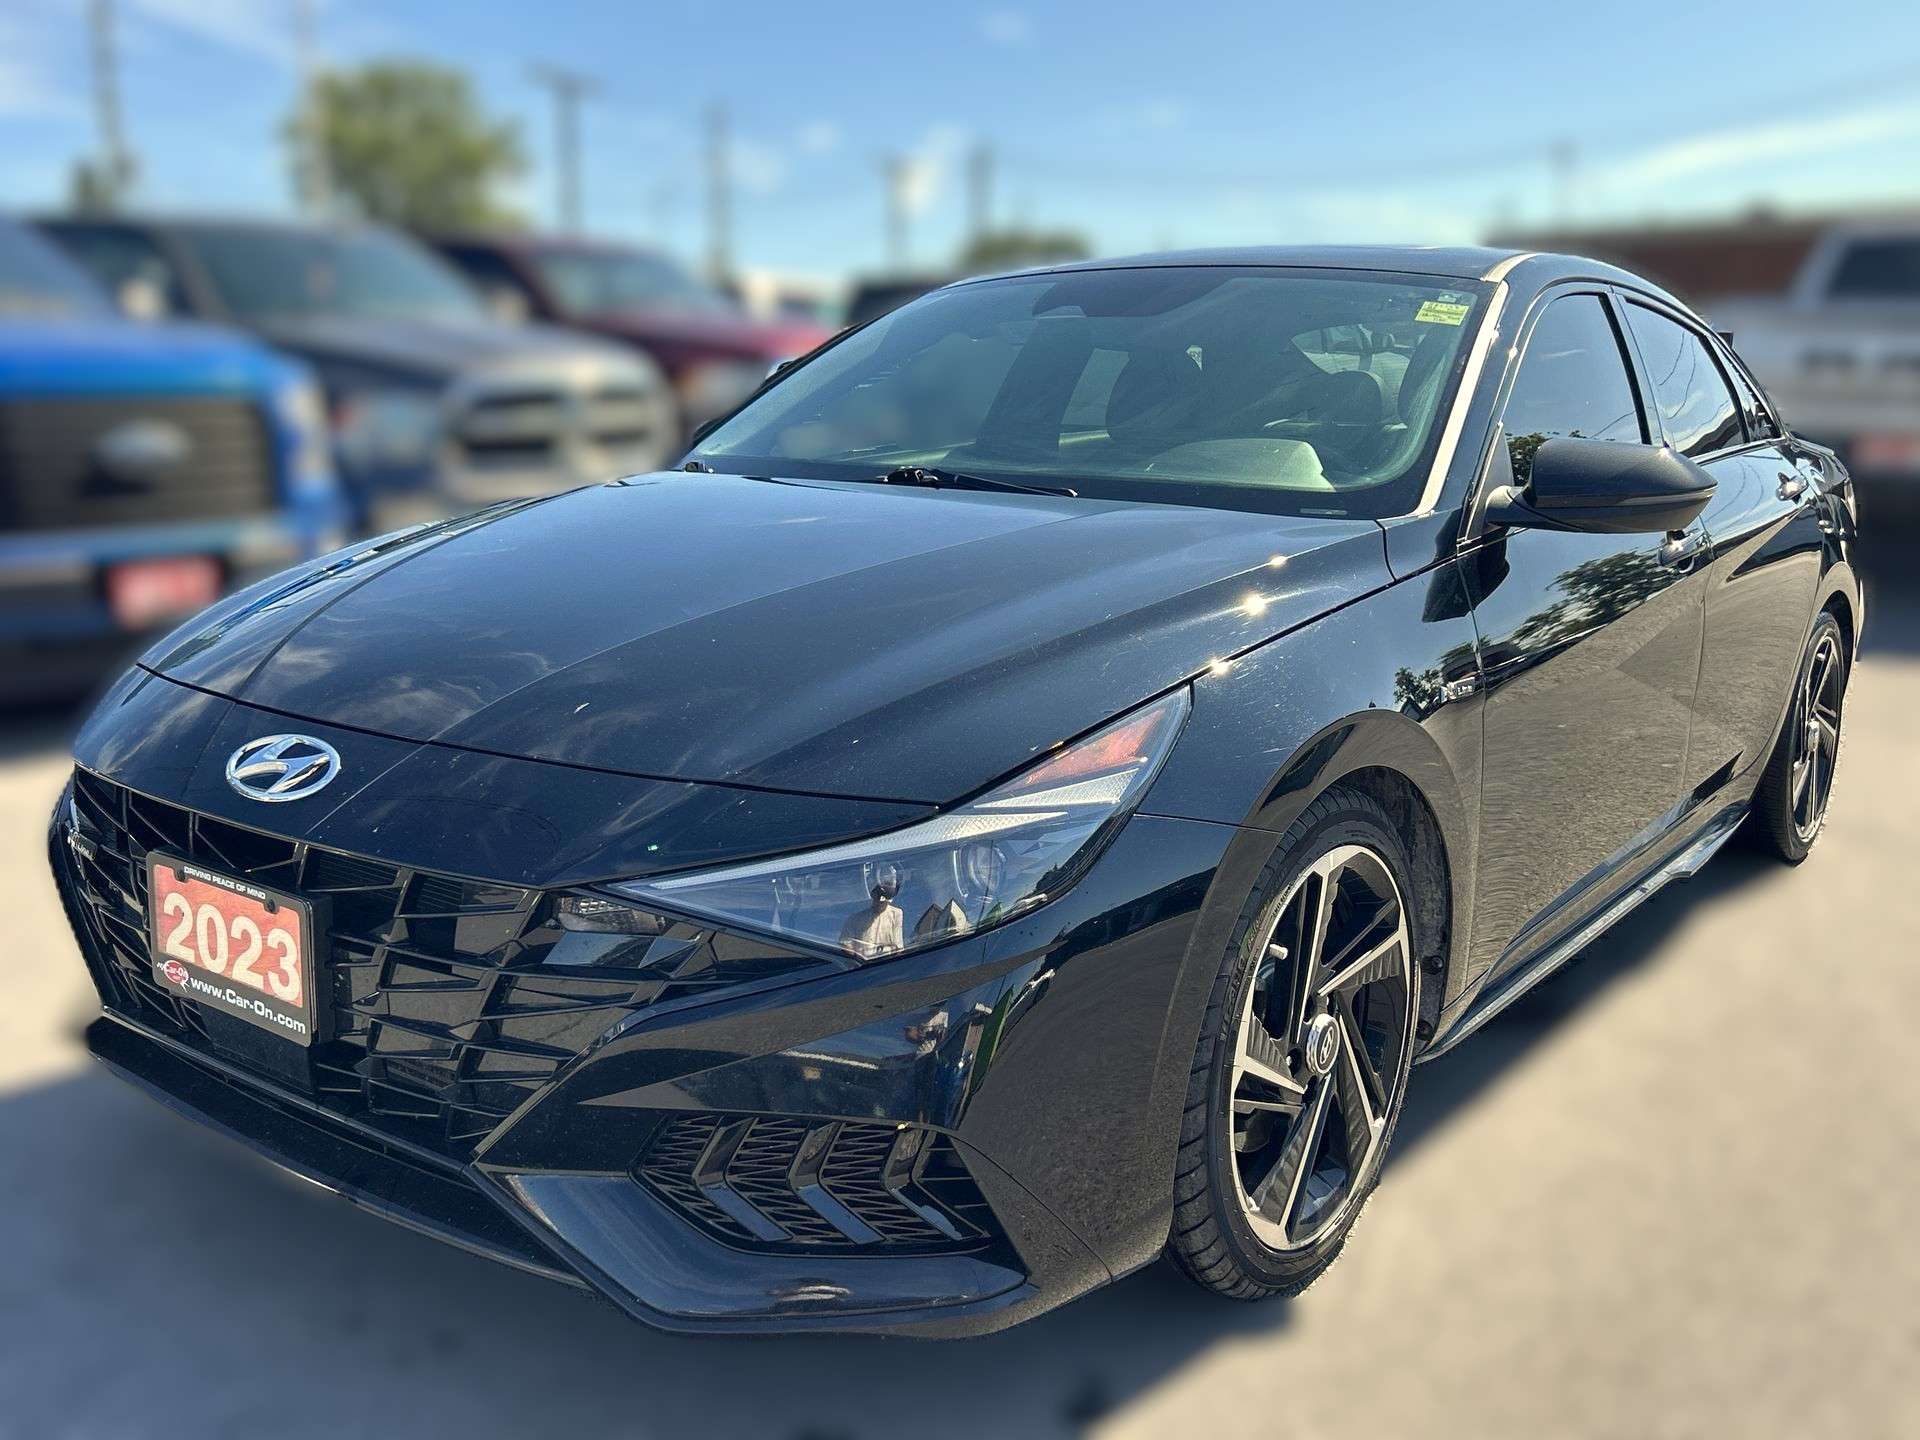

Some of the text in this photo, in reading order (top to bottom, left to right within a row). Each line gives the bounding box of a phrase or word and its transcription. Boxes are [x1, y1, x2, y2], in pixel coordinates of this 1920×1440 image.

[183, 866, 266, 900] DRIVING PEACE OF MIND
[163, 892, 303, 1001] 2023
[190, 977, 306, 1034] www.Car-On.com
